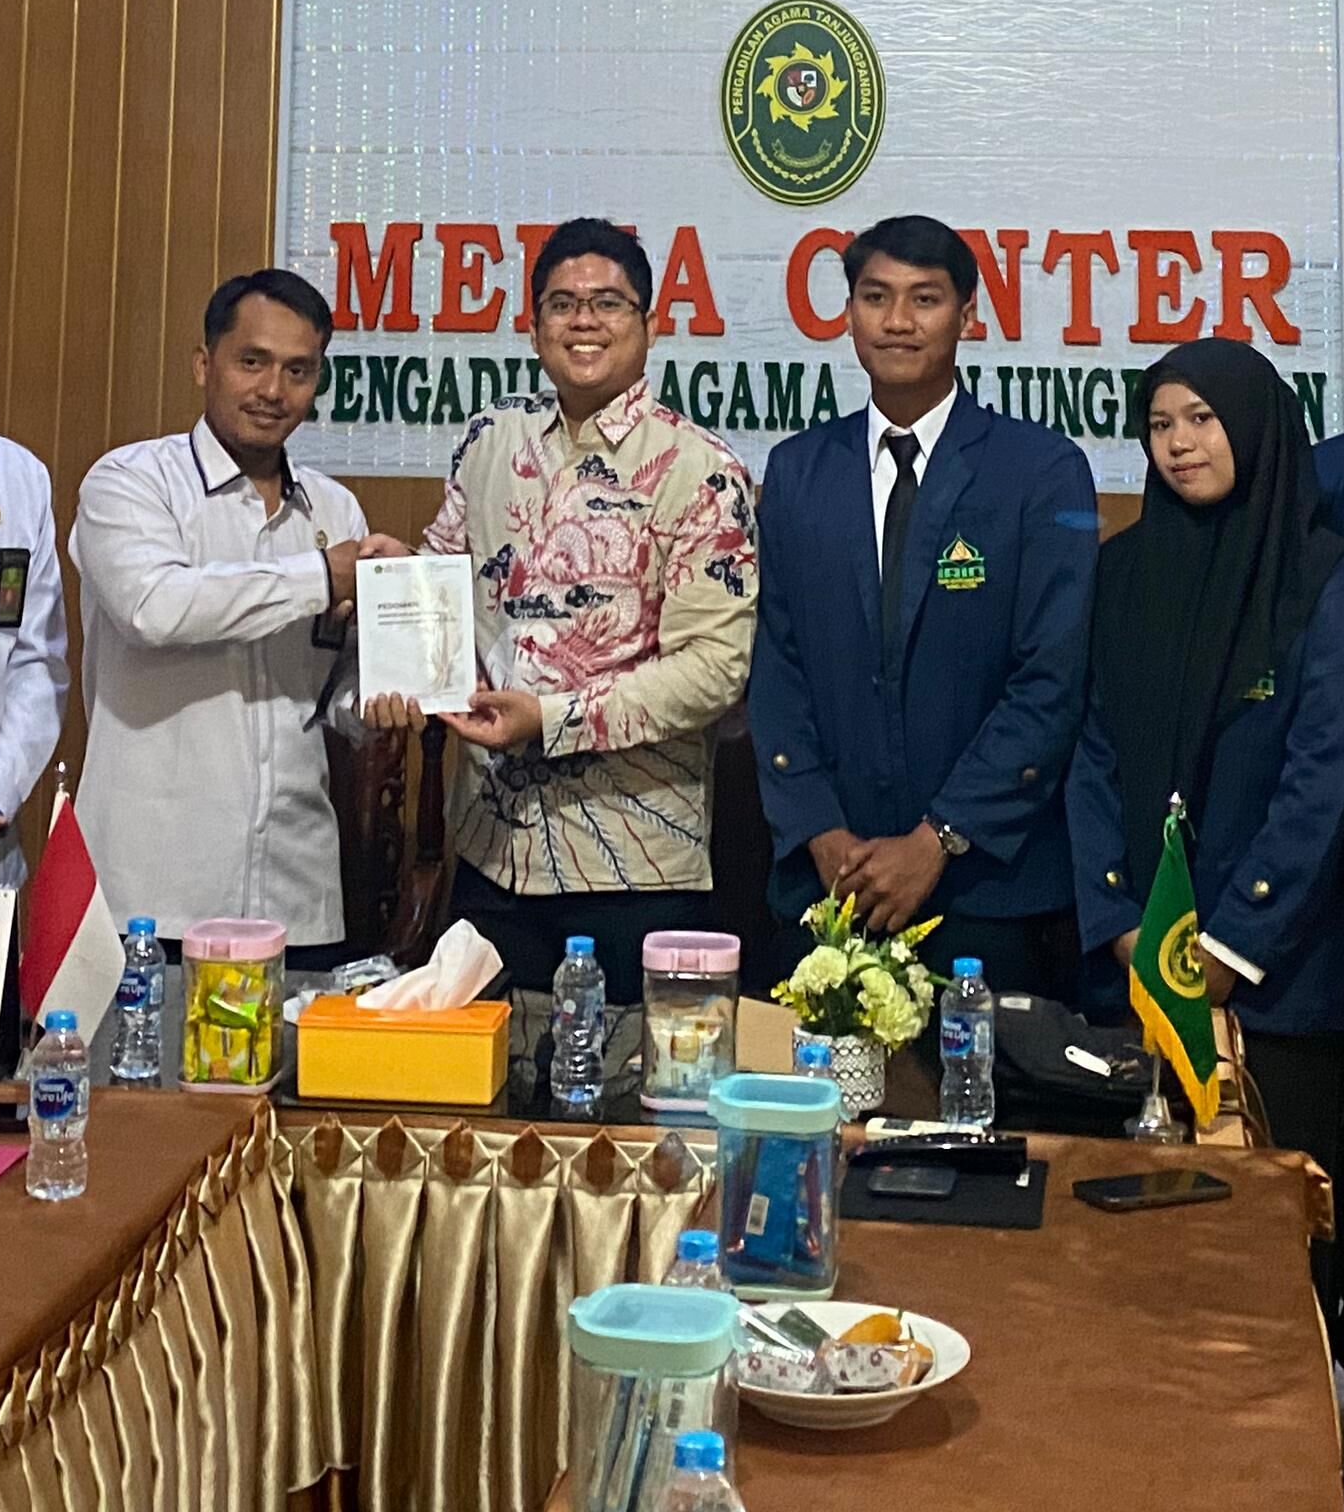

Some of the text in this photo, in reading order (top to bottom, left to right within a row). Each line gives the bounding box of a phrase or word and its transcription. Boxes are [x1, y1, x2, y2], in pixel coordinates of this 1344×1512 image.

[733, 7, 872, 116] PENGADILAN AGAMA TANJUNGPANDAN
[330, 222, 1302, 346] MEA CNTER
[657, 359, 840, 431] AGAMA
